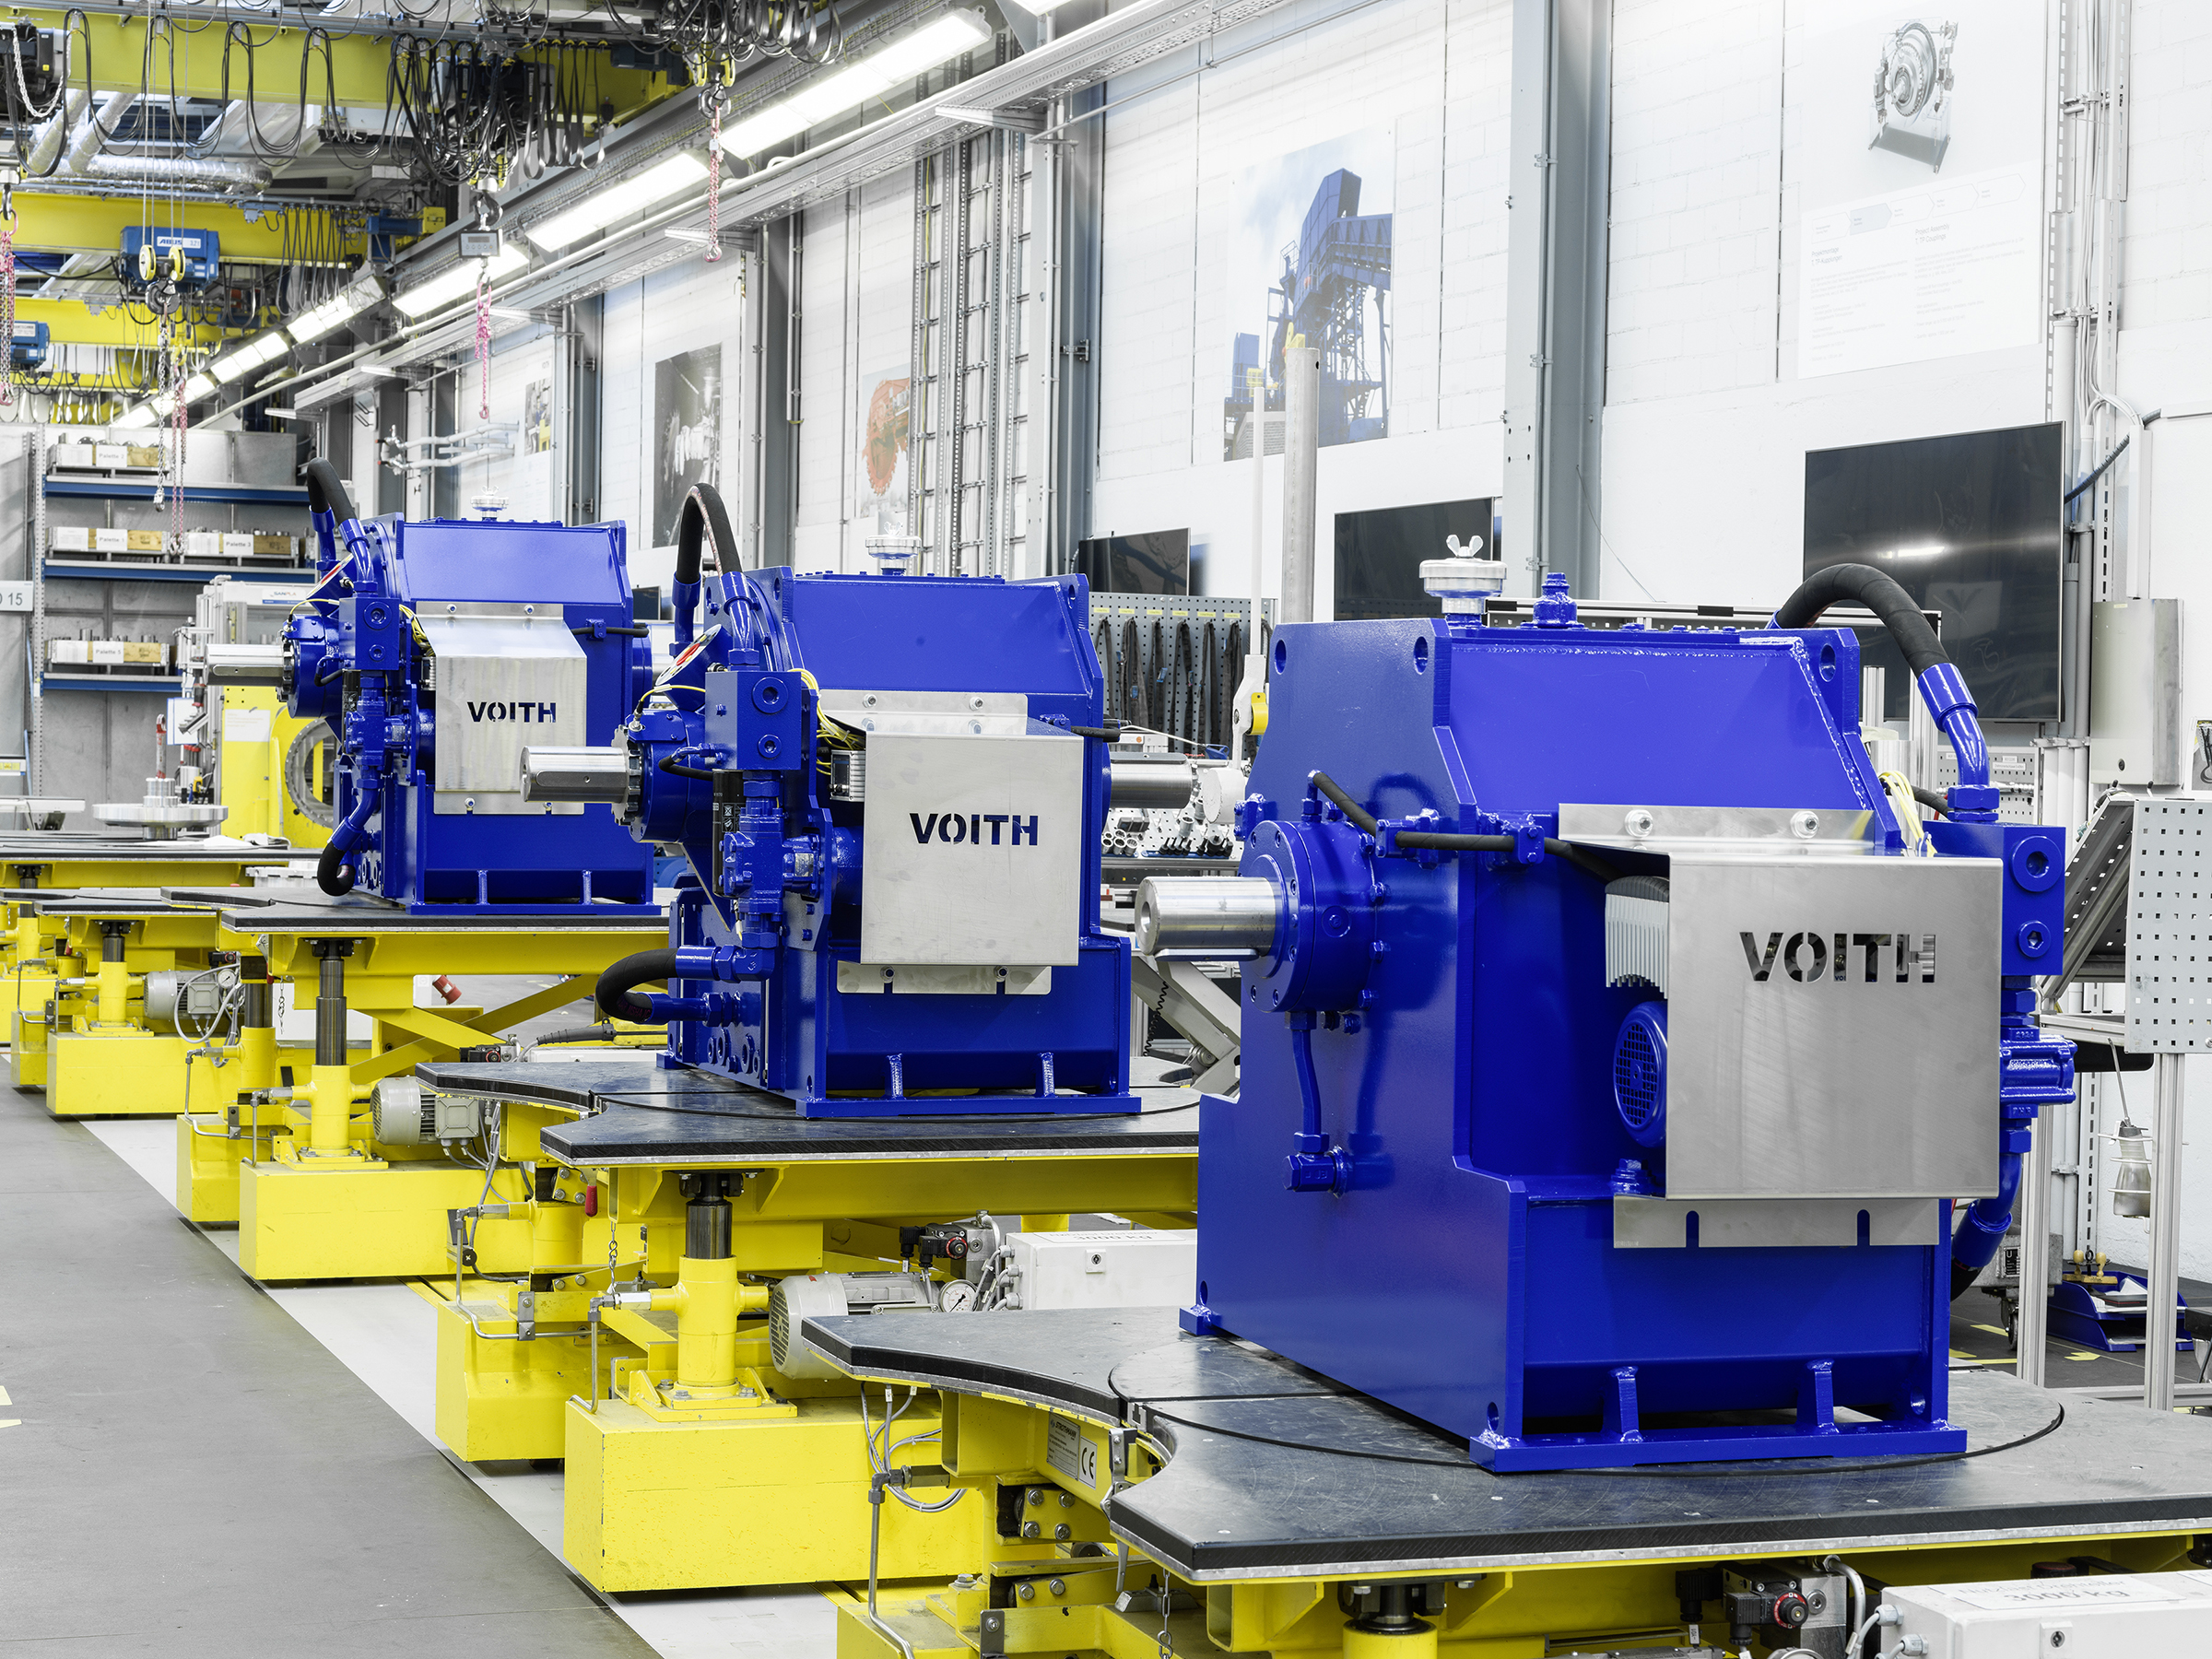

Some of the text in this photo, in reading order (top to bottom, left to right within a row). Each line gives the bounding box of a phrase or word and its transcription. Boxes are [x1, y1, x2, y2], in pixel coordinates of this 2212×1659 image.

[7, 592, 23, 606] 15
[467, 702, 556, 723] VOITH
[910, 813, 1038, 846] VOITH
[1739, 931, 1936, 983] VOITH
[2004, 1590, 2131, 1601] 3000 kg
